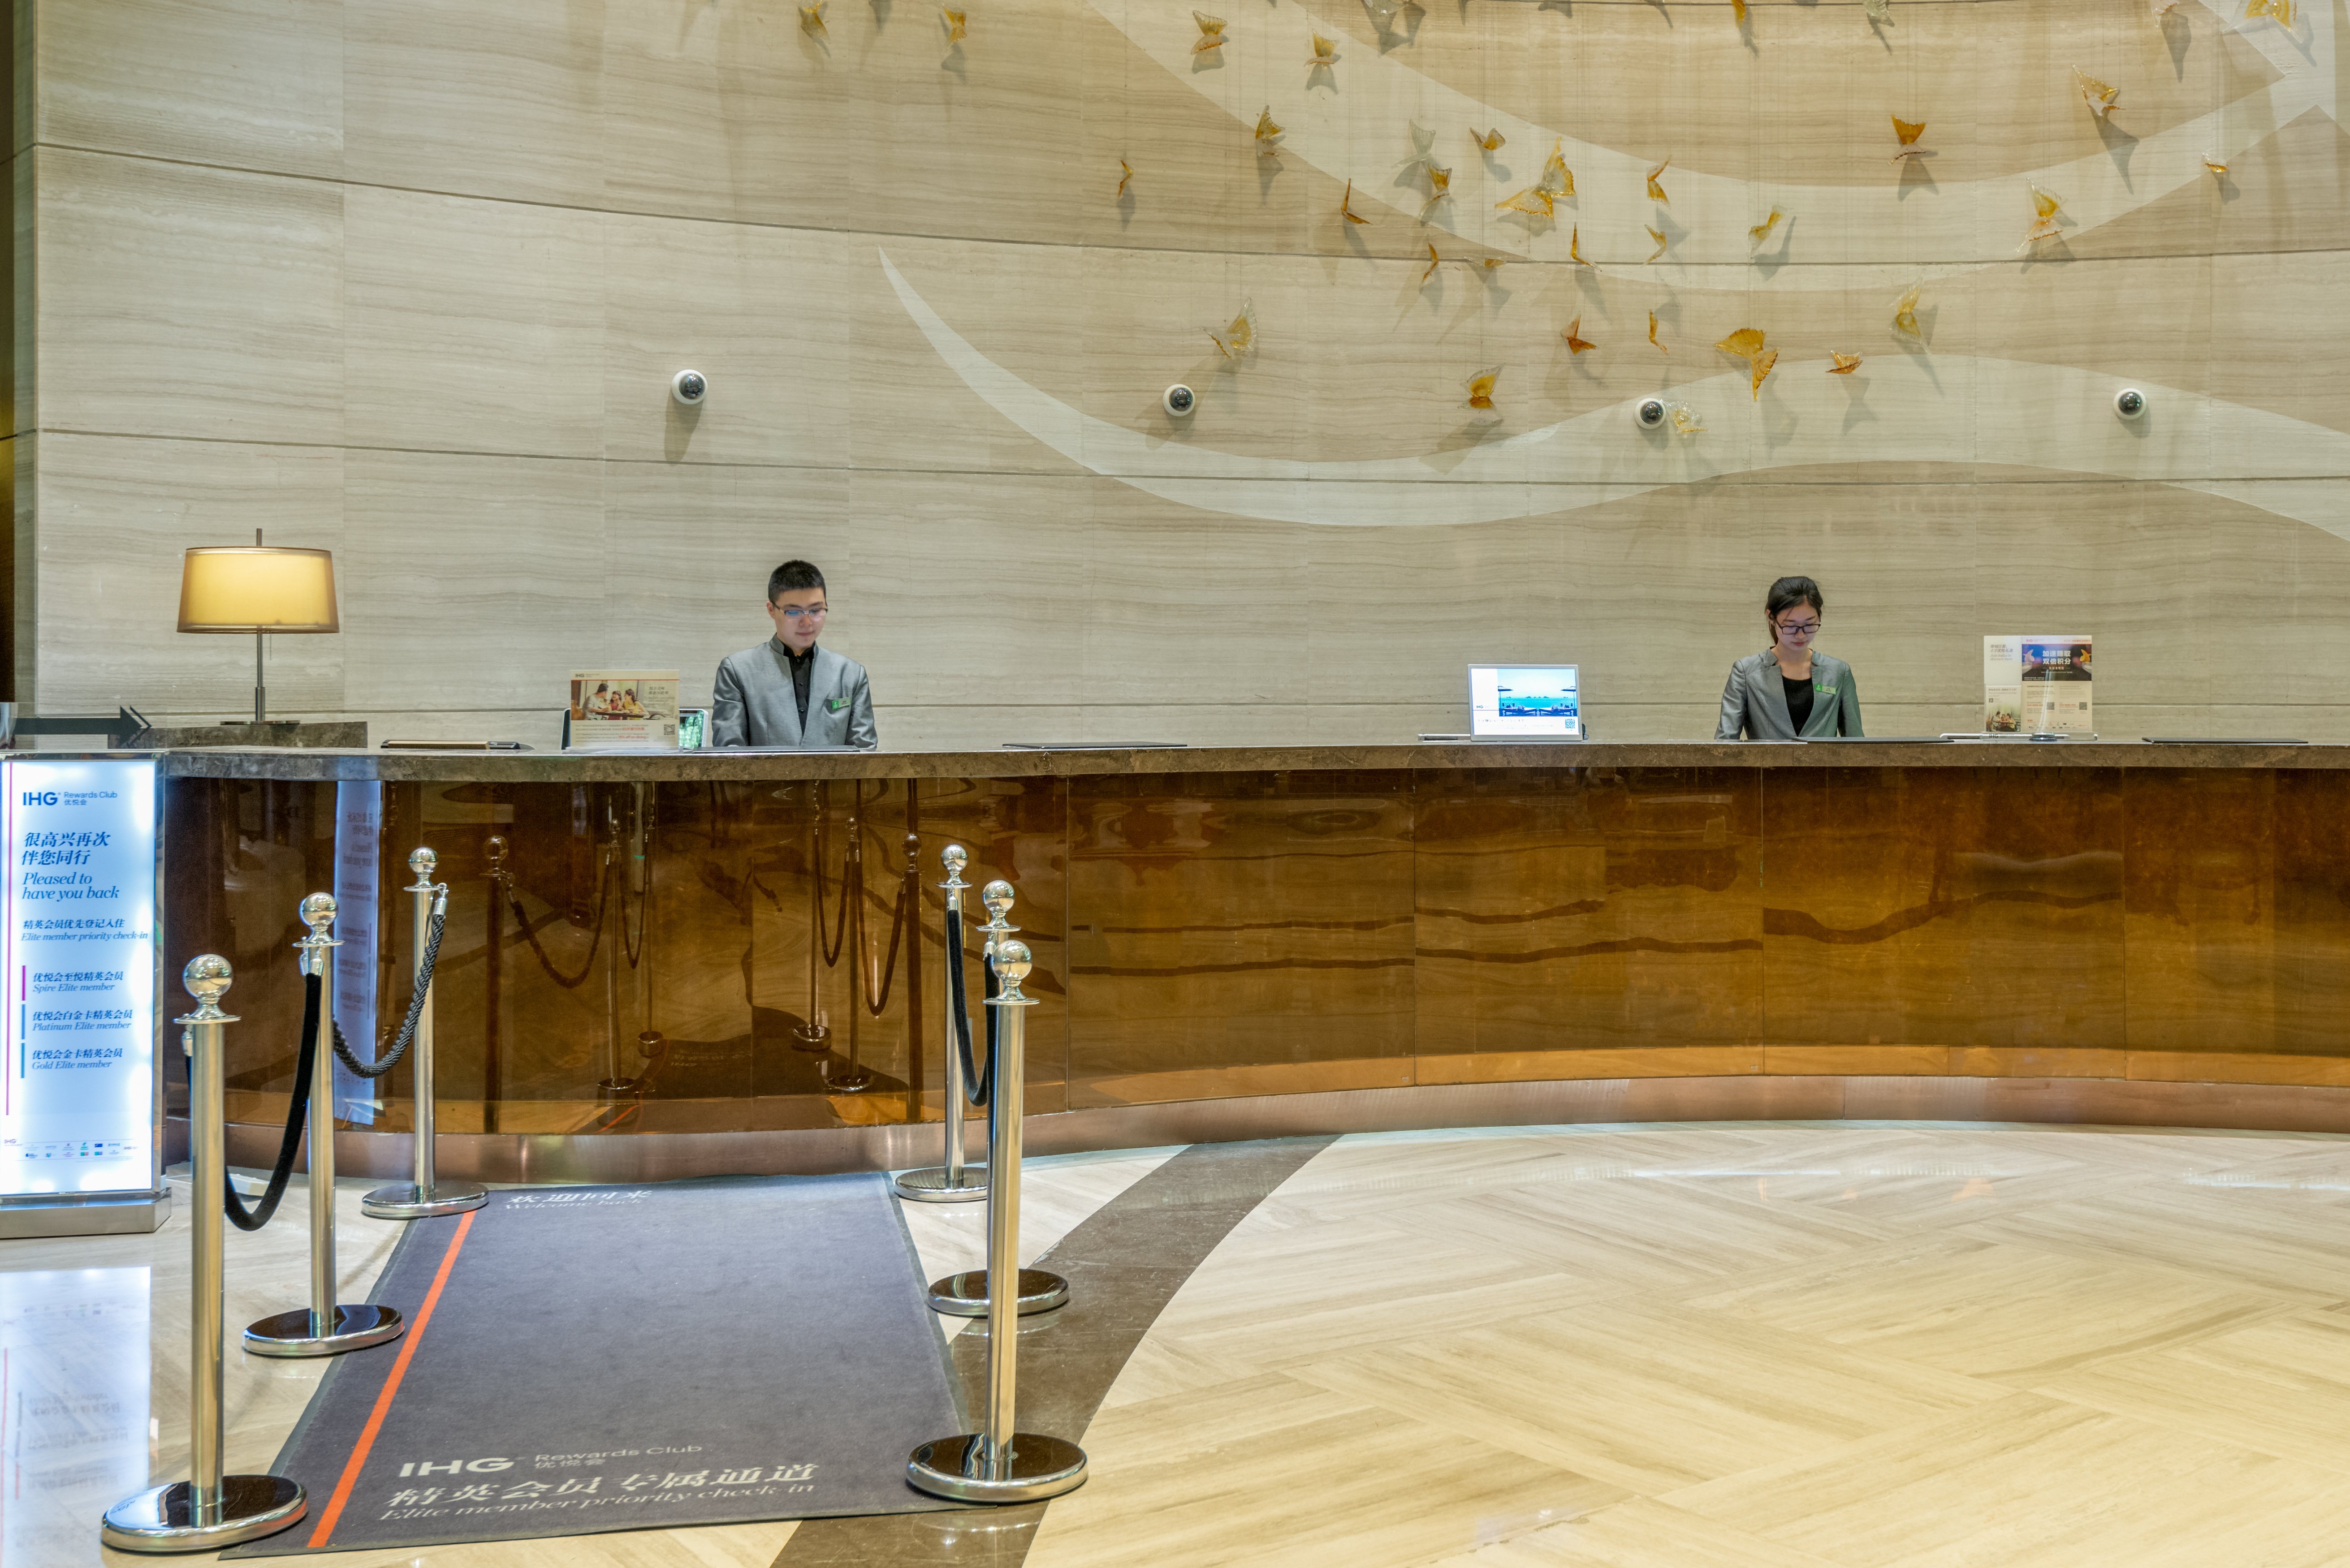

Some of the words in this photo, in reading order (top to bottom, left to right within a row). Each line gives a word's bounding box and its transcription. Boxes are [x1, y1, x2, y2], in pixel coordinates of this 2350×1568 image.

[23, 792, 58, 806] IHG
[24, 831, 111, 847] 很高兴再次
[22, 850, 91, 866] 伴您同行
[22, 872, 77, 885] Pleased
[79, 874, 92, 884] to
[22, 887, 55, 899] have
[56, 890, 83, 902] you
[86, 886, 119, 898] back
[24, 918, 125, 929] 精英会员优先登记入住
[43, 932, 78, 940] member
[78, 932, 111, 942] priority
[113, 931, 148, 939] check-in
[33, 971, 124, 982] 优悦会至悦精英会员
[33, 984, 56, 994] Spire
[57, 983, 78, 991] Elite
[79, 983, 115, 991] member
[32, 1009, 133, 1021] 优悦会白金卡精英会员
[32, 1023, 72, 1031] Platinum
[74, 1022, 95, 1030] Elite
[96, 1021, 132, 1030] member
[32, 1048, 123, 1060] 优悦会金卡精英会员
[32, 1061, 54, 1070] Gold
[77, 1060, 112, 1068] member
[399, 1457, 515, 1477] IHG
[535, 1449, 639, 1461] Rewards
[646, 1445, 703, 1455] Club
[535, 1458, 606, 1469] 优悦会
[382, 1464, 819, 1507] 精英会员专属通道
[378, 1508, 449, 1520] Elite
[454, 1499, 577, 1515] member
[579, 1492, 692, 1509] priority
